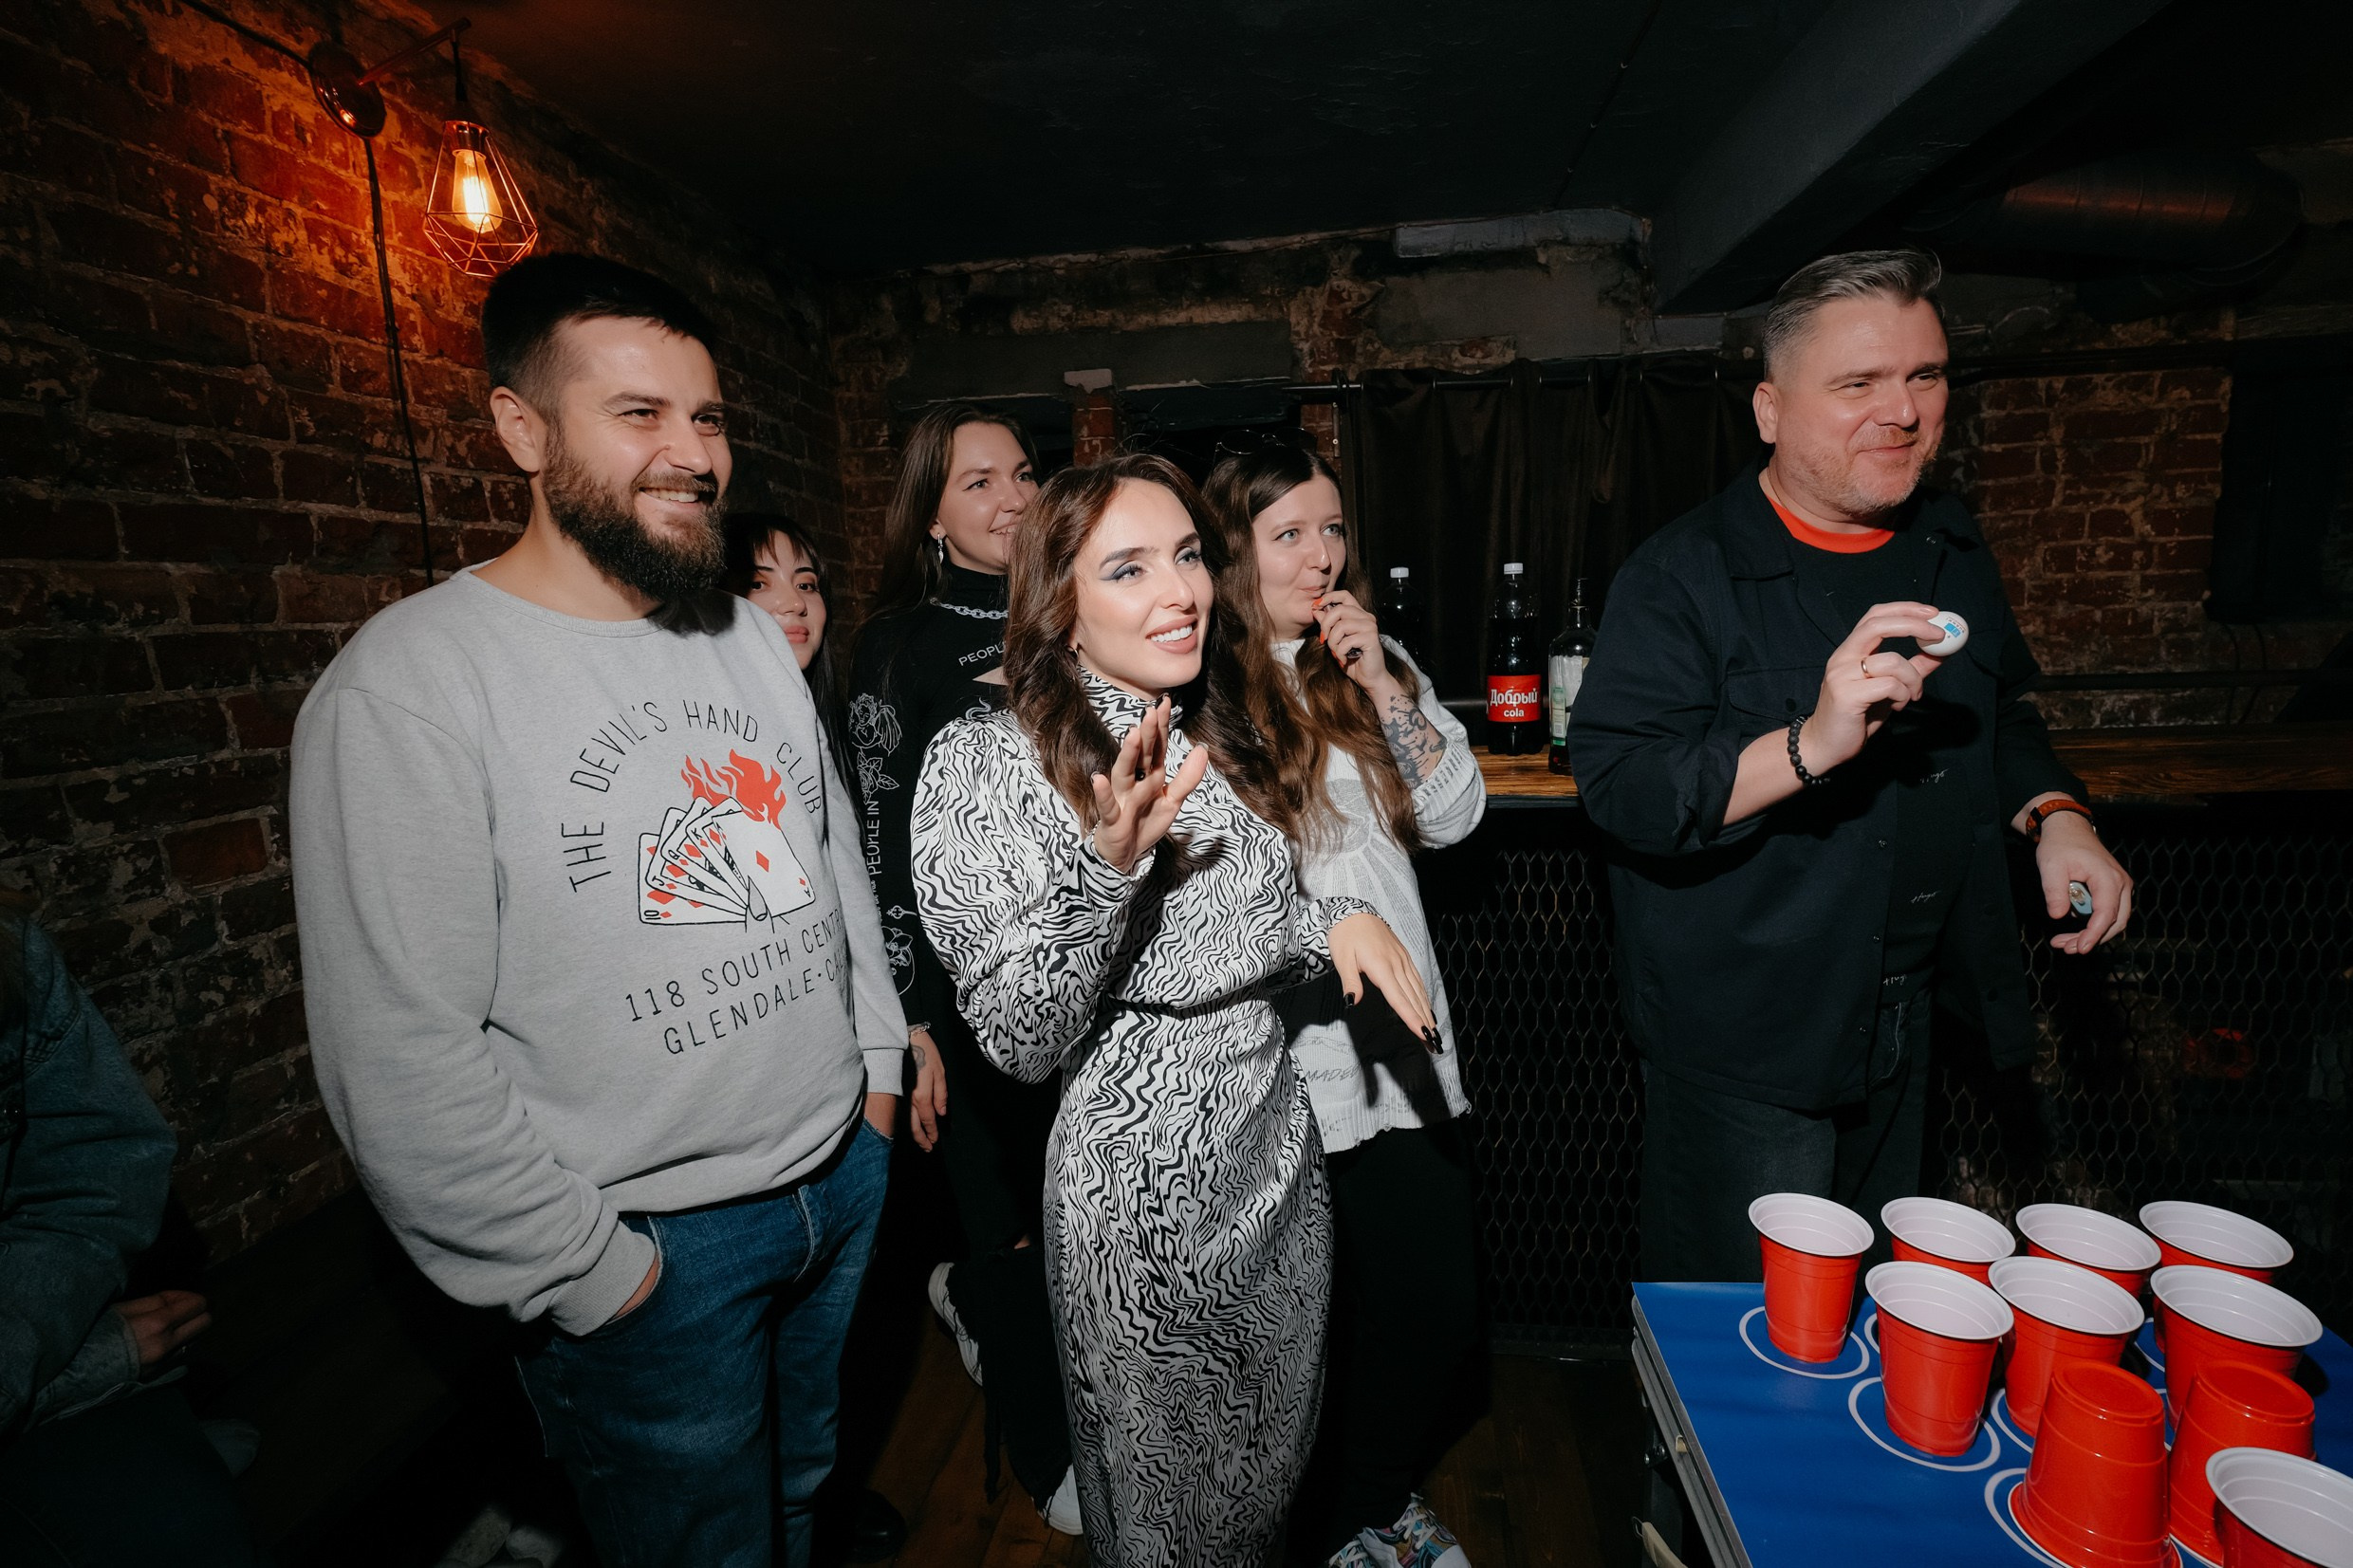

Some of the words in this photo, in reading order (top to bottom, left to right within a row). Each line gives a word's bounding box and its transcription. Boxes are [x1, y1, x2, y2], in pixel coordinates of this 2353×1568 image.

[958, 641, 1006, 666] PEOPL
[1490, 688, 1538, 707] Добрый
[683, 700, 758, 742] HAND
[1503, 708, 1525, 717] cola
[570, 701, 668, 793] DEVIL'S
[775, 742, 823, 815] CLUB
[866, 801, 880, 815] IN
[691, 827, 703, 840] K
[562, 821, 612, 893] THE
[652, 876, 665, 886] J
[643, 910, 661, 920] 10
[625, 981, 686, 1023] 118
[702, 937, 791, 995] SOUTH
[801, 908, 843, 954] CENTR
